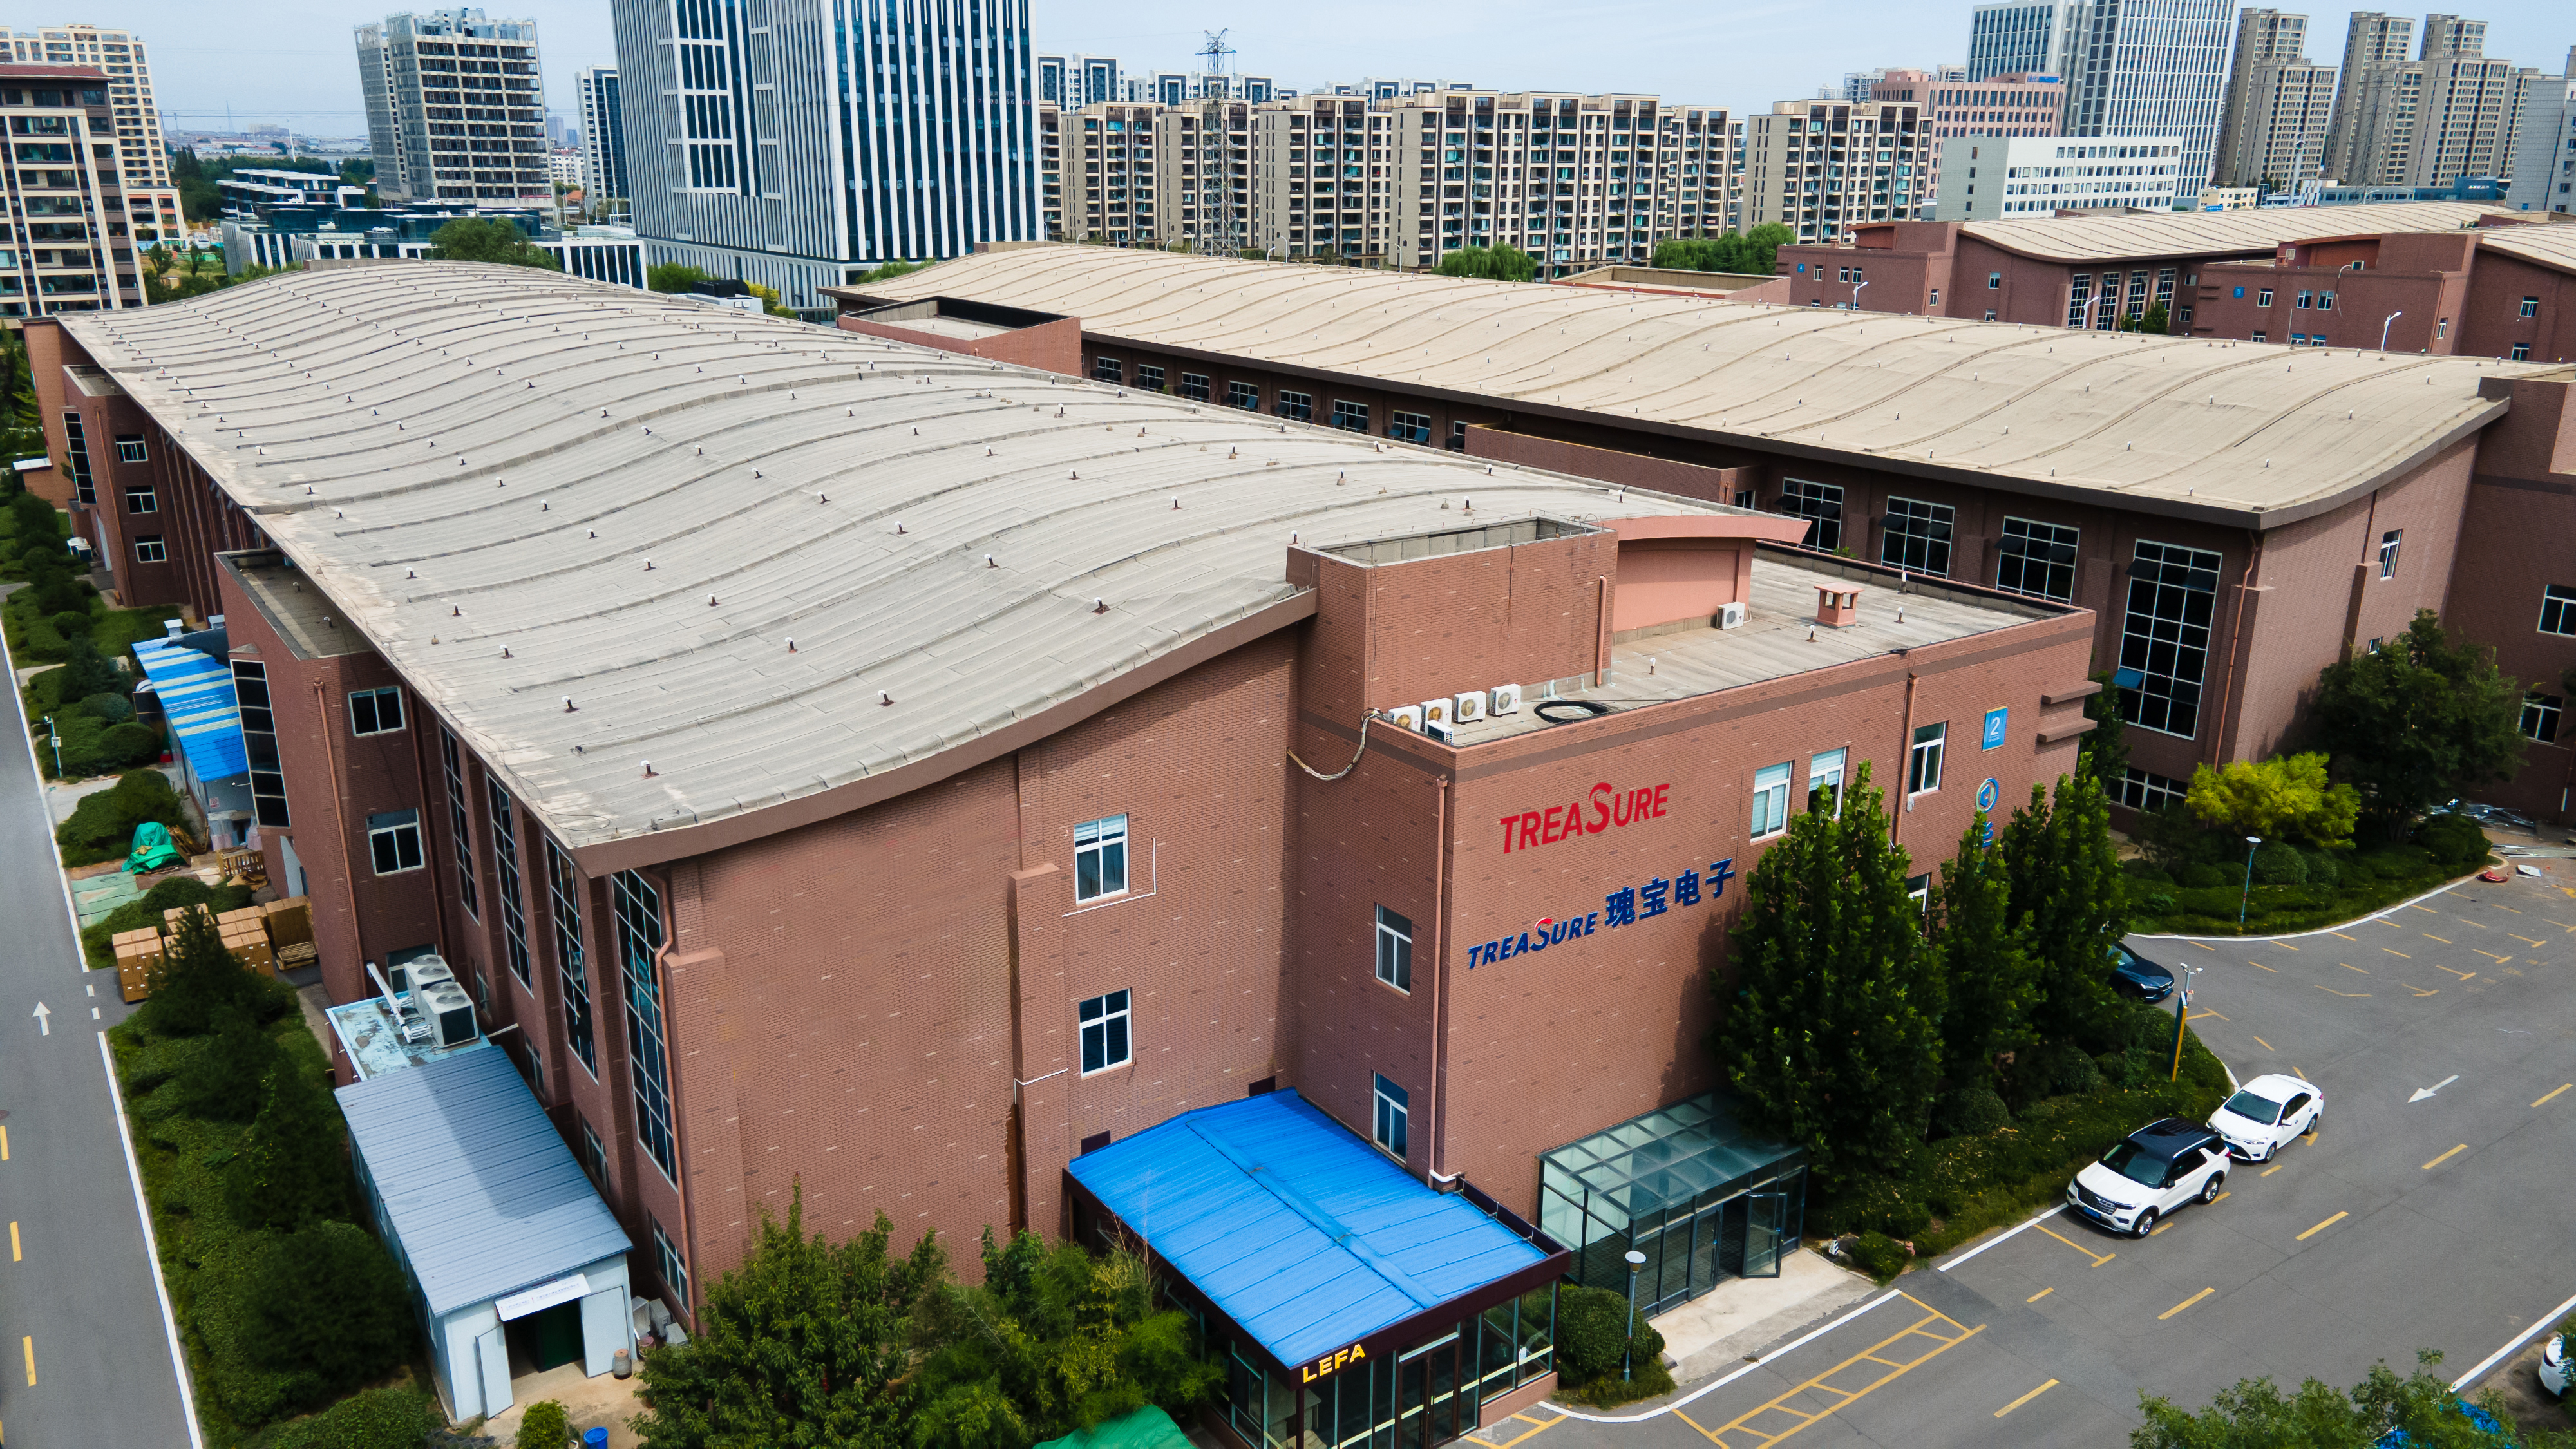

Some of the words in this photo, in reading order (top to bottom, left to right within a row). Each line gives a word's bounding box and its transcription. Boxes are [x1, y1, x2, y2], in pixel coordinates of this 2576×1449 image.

[1990, 717, 2000, 736] 2
[1499, 781, 1671, 855] TREASURE
[1468, 911, 1600, 969] TREASURE
[1604, 858, 1736, 928] 瑰宝电子
[1303, 1344, 1366, 1383] LEFA
